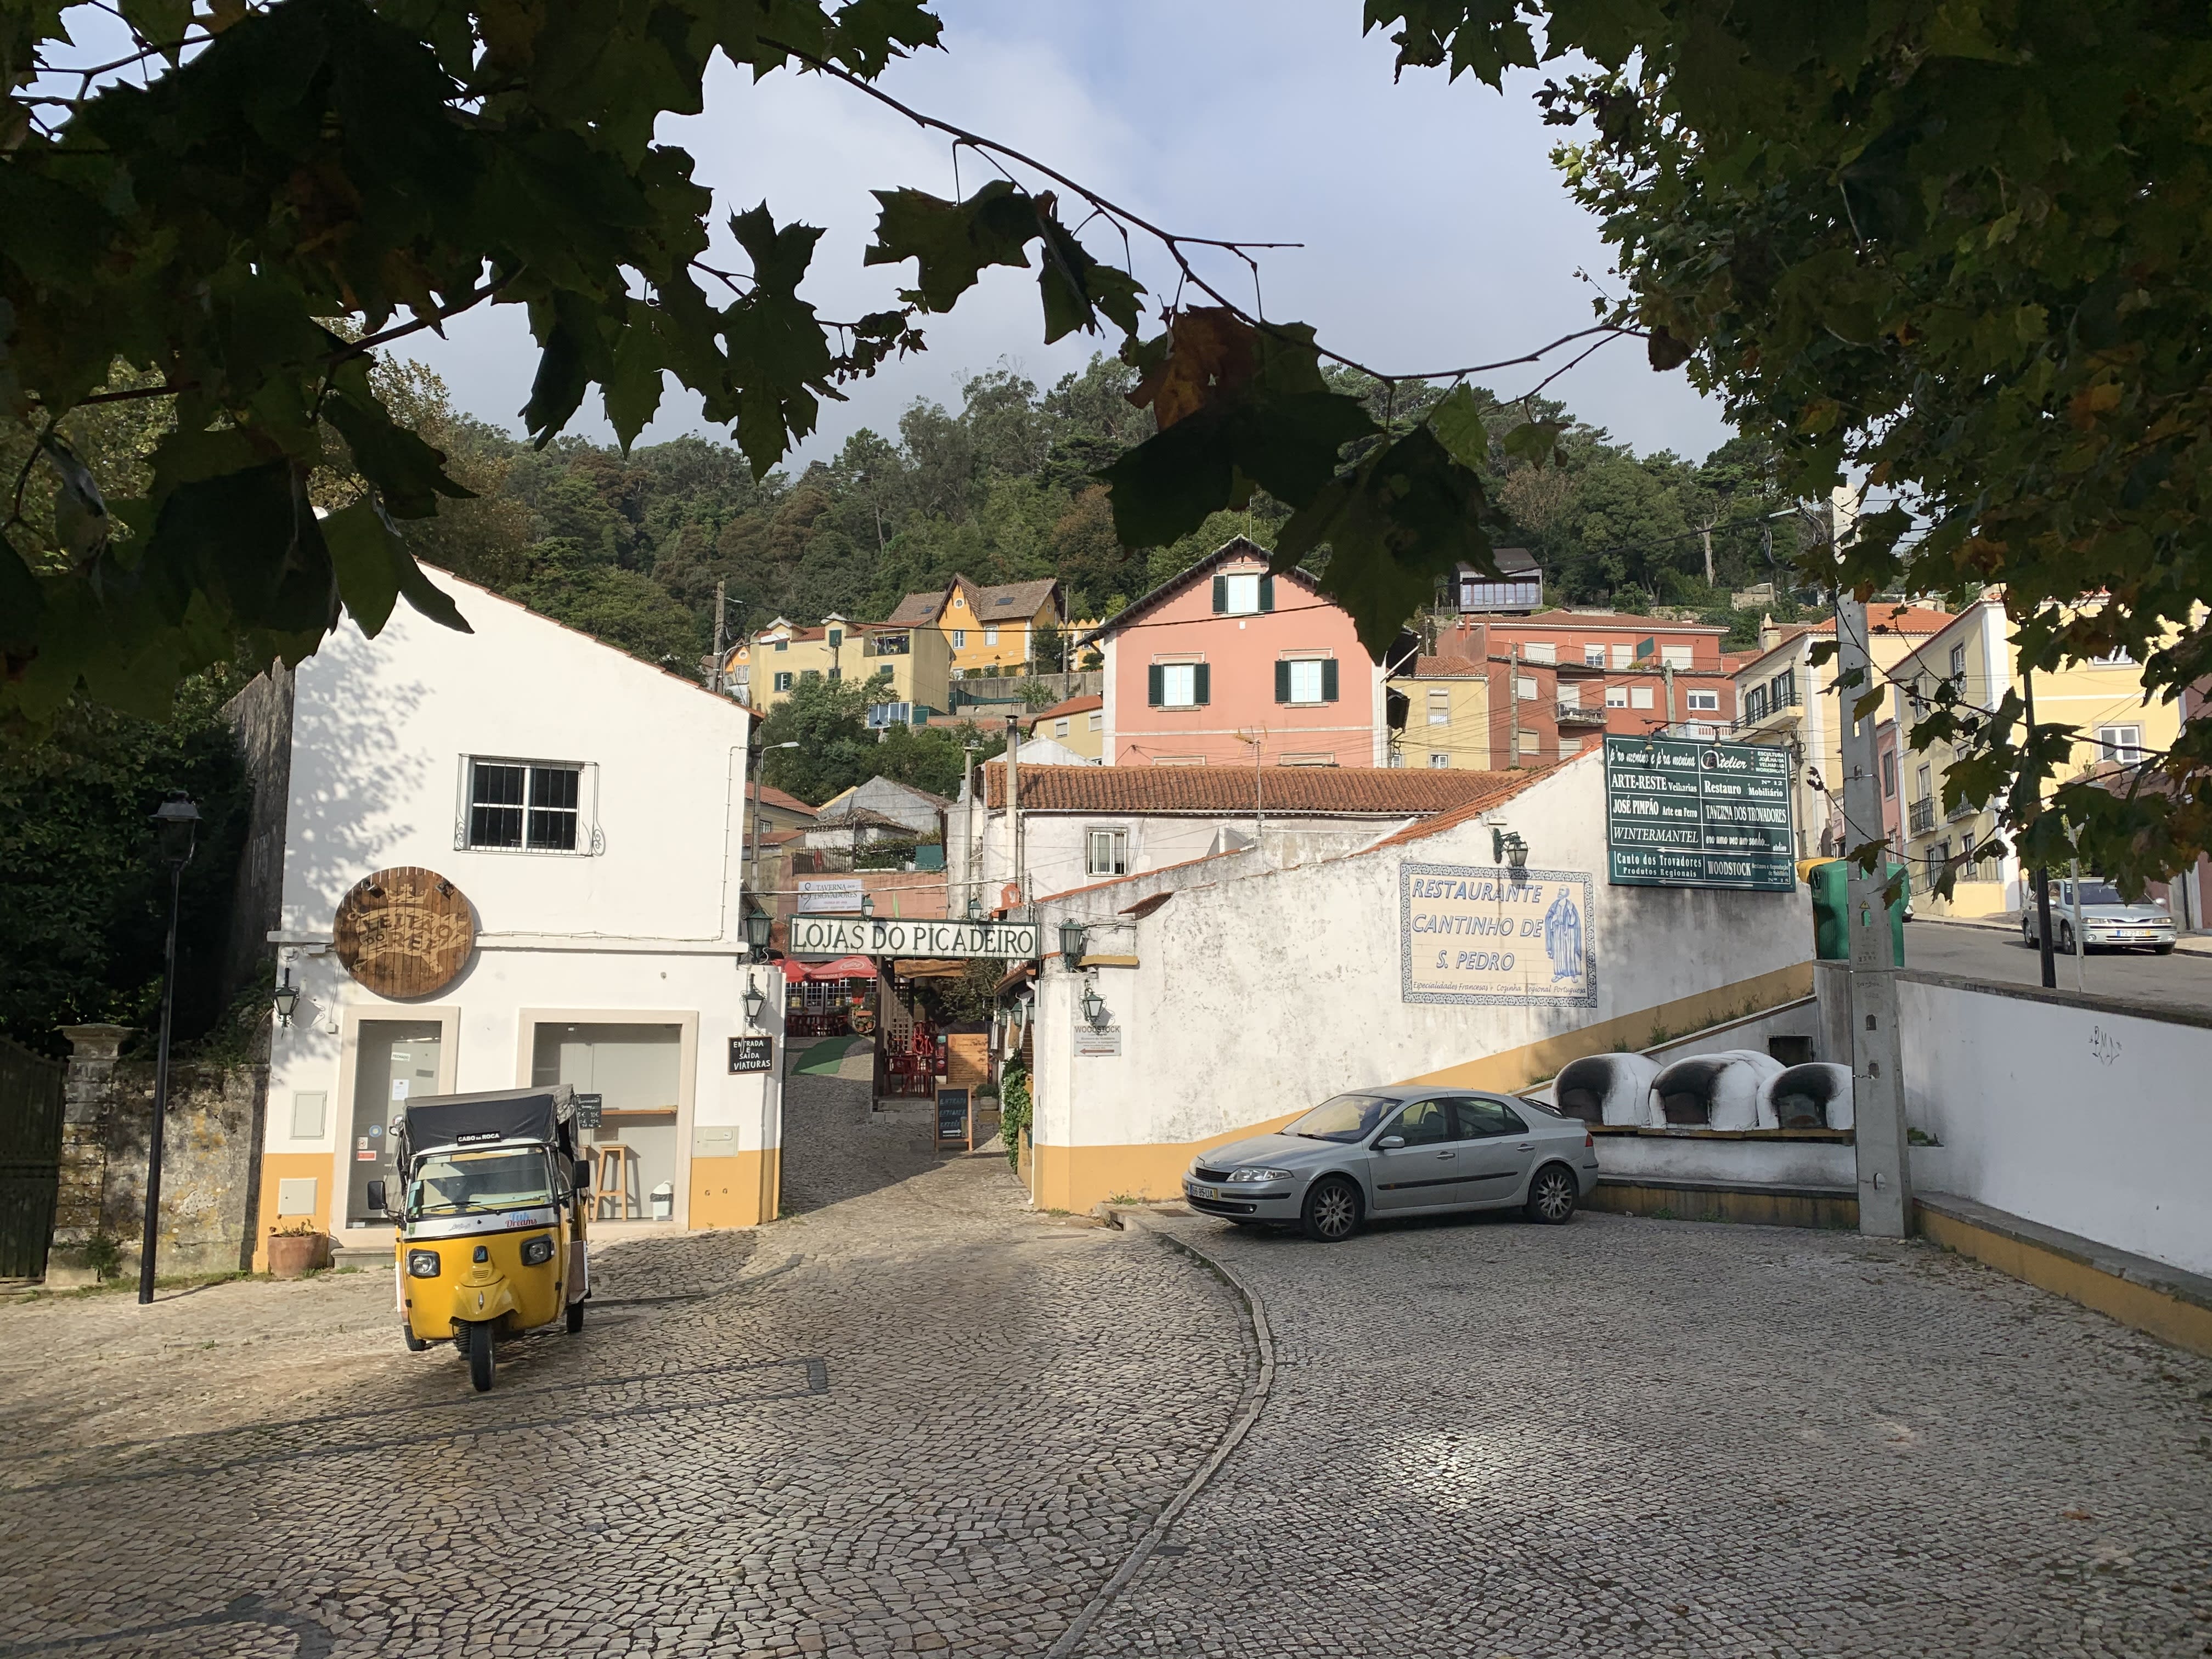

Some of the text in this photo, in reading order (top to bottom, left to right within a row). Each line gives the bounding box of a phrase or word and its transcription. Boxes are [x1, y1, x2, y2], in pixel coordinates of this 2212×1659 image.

[1651, 754, 1655, 764] e
[1672, 753, 1695, 767] menina
[1611, 774, 1697, 792] ARTE-RESTE Velharias
[1704, 780, 1783, 797] Restauro Mobiliário
[1613, 794, 1697, 818] JOSÉ PIMPÃO Arte em Ferro
[1706, 805, 1786, 823] TAVERNA DOS TROVADORES
[1613, 826, 1699, 843] WINTERMANTEL
[1617, 853, 1702, 868] Canto dos Trovadores
[1707, 861, 1752, 876] WOODSTOCK
[1623, 867, 1696, 878] Produtos Regionais
[1412, 878, 1543, 903] RESTAURANTE
[1412, 913, 1543, 937] CANTINHO DE
[793, 923, 1033, 953] LOJAS DO PICADEIRO
[1436, 950, 1514, 970] S. PEDRO
[1413, 981, 1457, 990] Especialidades
[1459, 983, 1488, 991] Francesas
[1497, 984, 1522, 994] Cozinha
[1525, 985, 1551, 994] Regional
[1553, 985, 1586, 995] Portuguesa
[733, 1060, 771, 1070] VIATURAS
[505, 1218, 537, 1228] Dreams
[509, 1211, 529, 1222] Tuk
